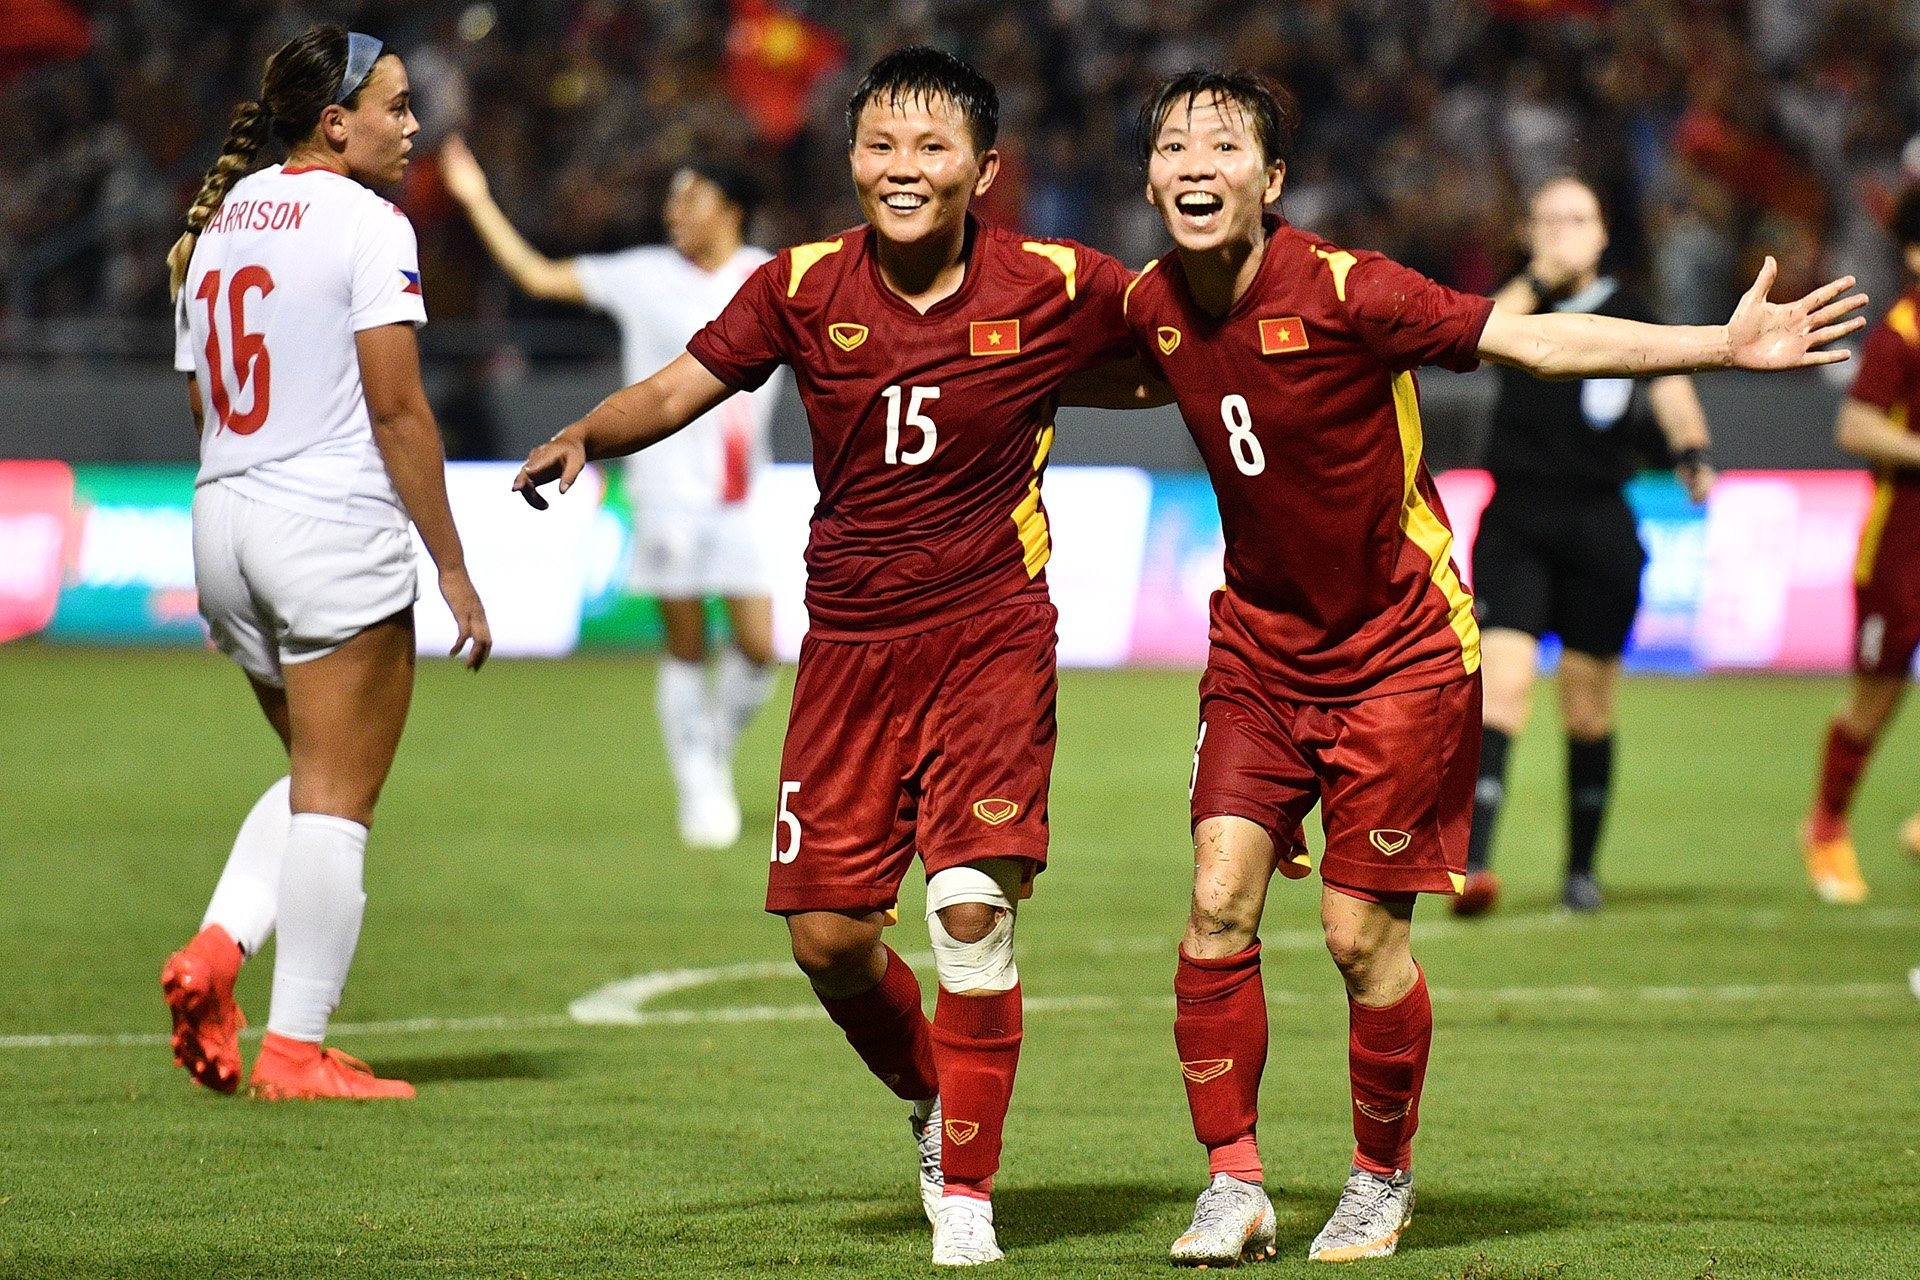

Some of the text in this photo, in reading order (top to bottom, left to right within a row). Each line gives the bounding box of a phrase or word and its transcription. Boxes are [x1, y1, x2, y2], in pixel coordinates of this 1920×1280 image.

[195, 264, 275, 437] 16
[881, 385, 941, 465] 15
[1221, 394, 1266, 476] 8
